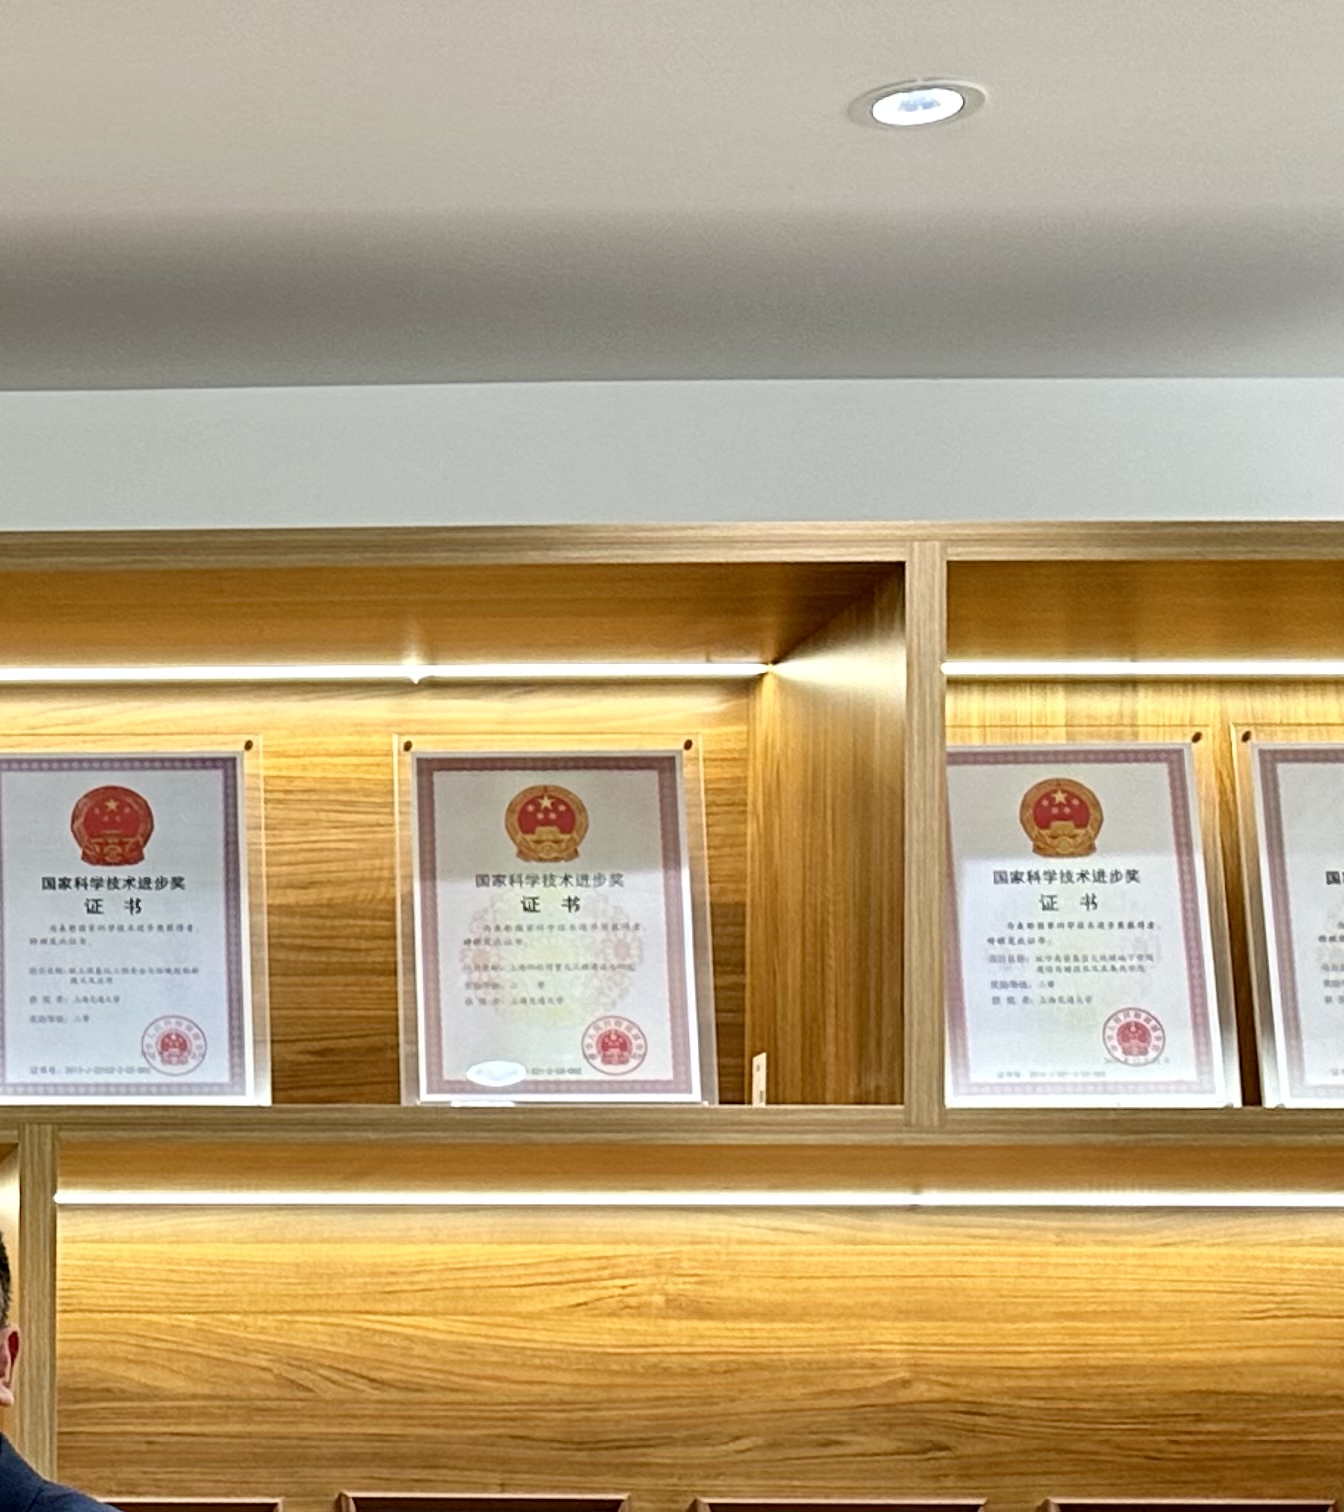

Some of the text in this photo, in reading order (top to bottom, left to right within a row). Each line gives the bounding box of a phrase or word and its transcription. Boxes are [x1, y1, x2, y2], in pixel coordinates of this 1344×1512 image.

[41, 876, 185, 891] 国家科学技术进步奖
[475, 873, 625, 888] 国家科学技术进步奖
[992, 868, 1142, 885] 国家科学技术进步奖
[84, 898, 142, 916] 证书
[520, 895, 581, 913] 证书
[1039, 893, 1099, 912] 证书
